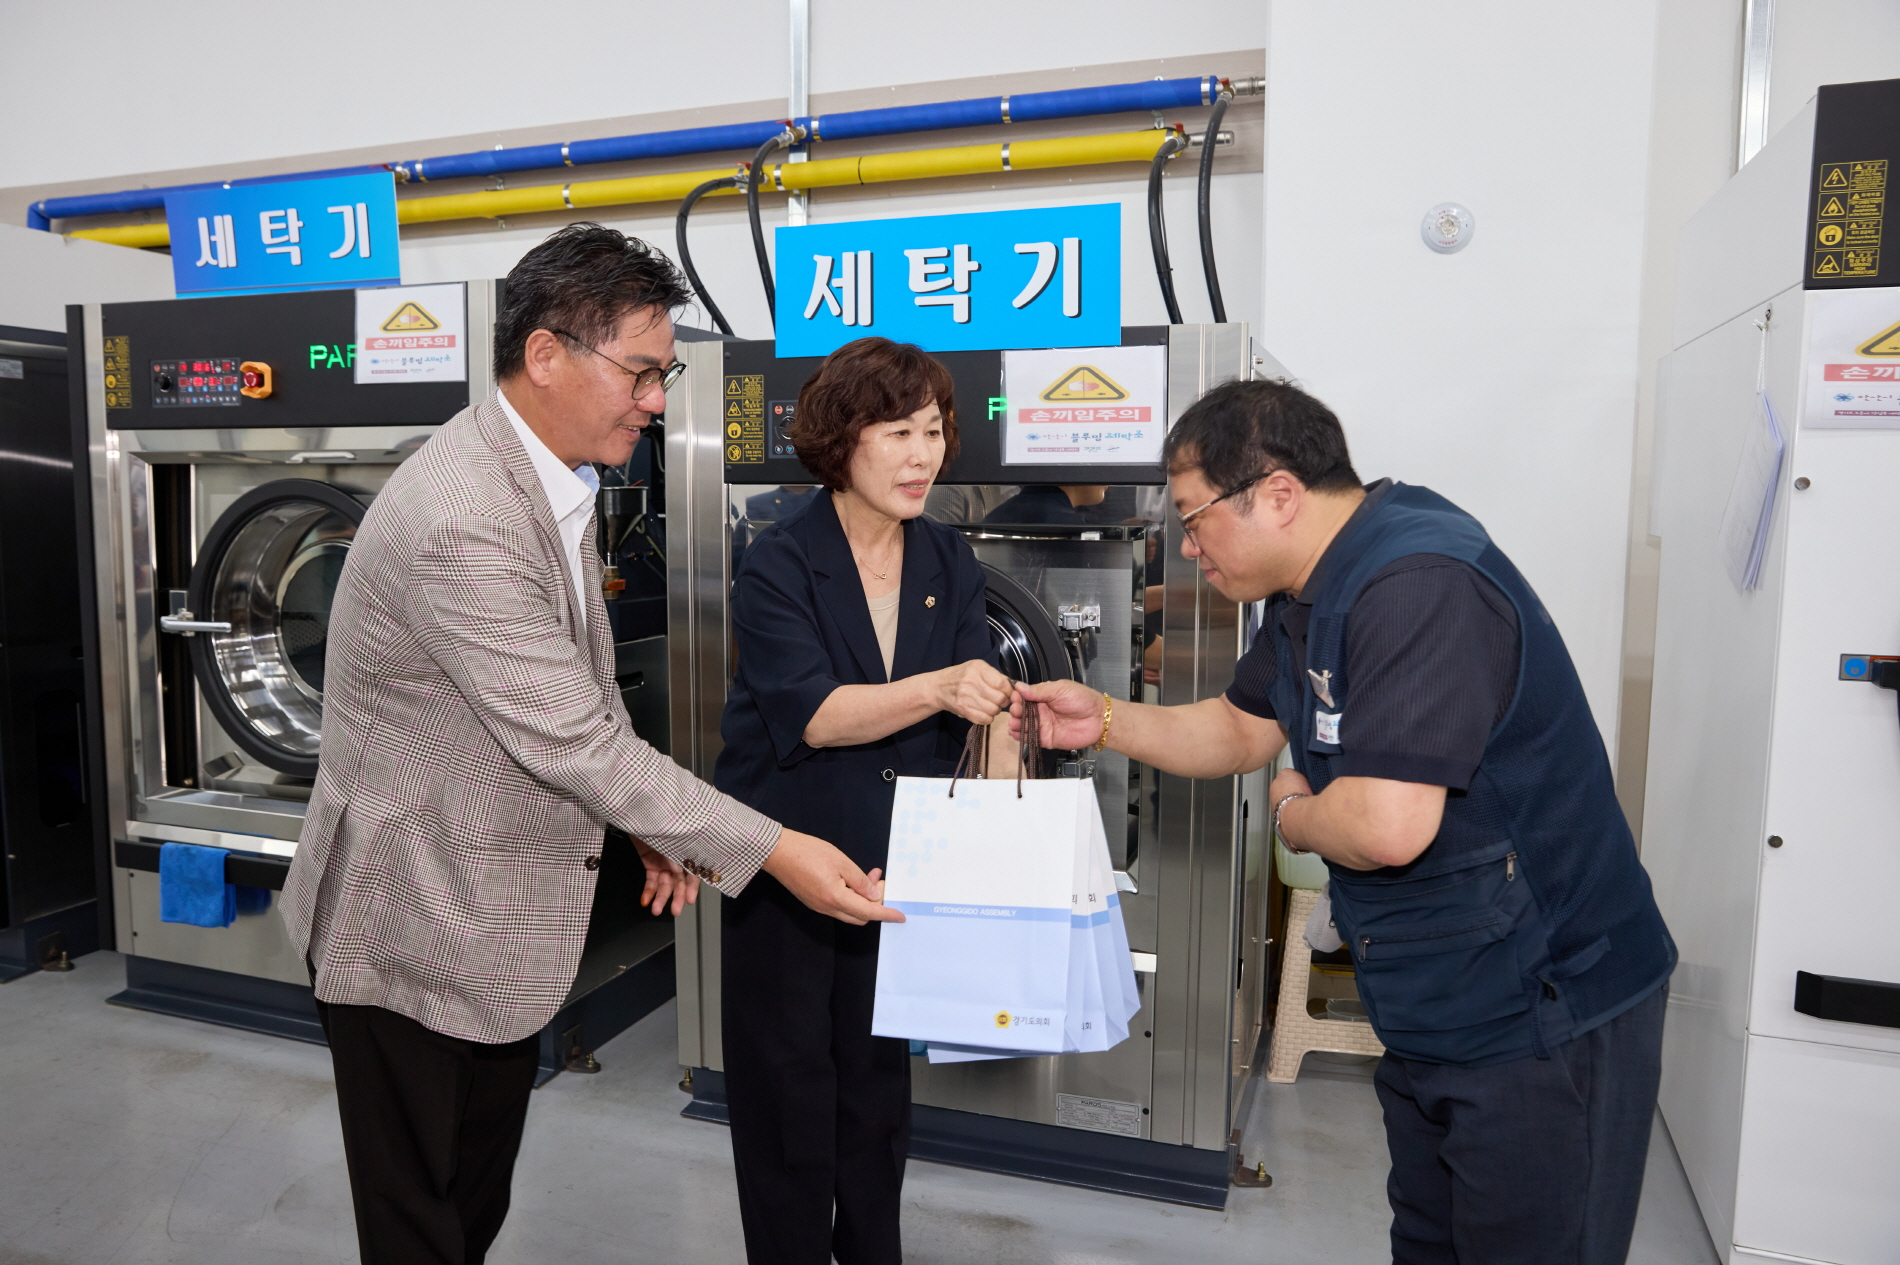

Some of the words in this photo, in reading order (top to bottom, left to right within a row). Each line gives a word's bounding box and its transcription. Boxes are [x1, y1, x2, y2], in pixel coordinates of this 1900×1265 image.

[196, 202, 371, 268] 세탁기
[803, 237, 1082, 327] 세탁기
[1030, 408, 1139, 422] 손끼임주의
[933, 905, 979, 916] GYEONGGIDO
[980, 908, 1017, 917] ASSEMBLY
[1012, 1016, 1050, 1027] 경기도의회
